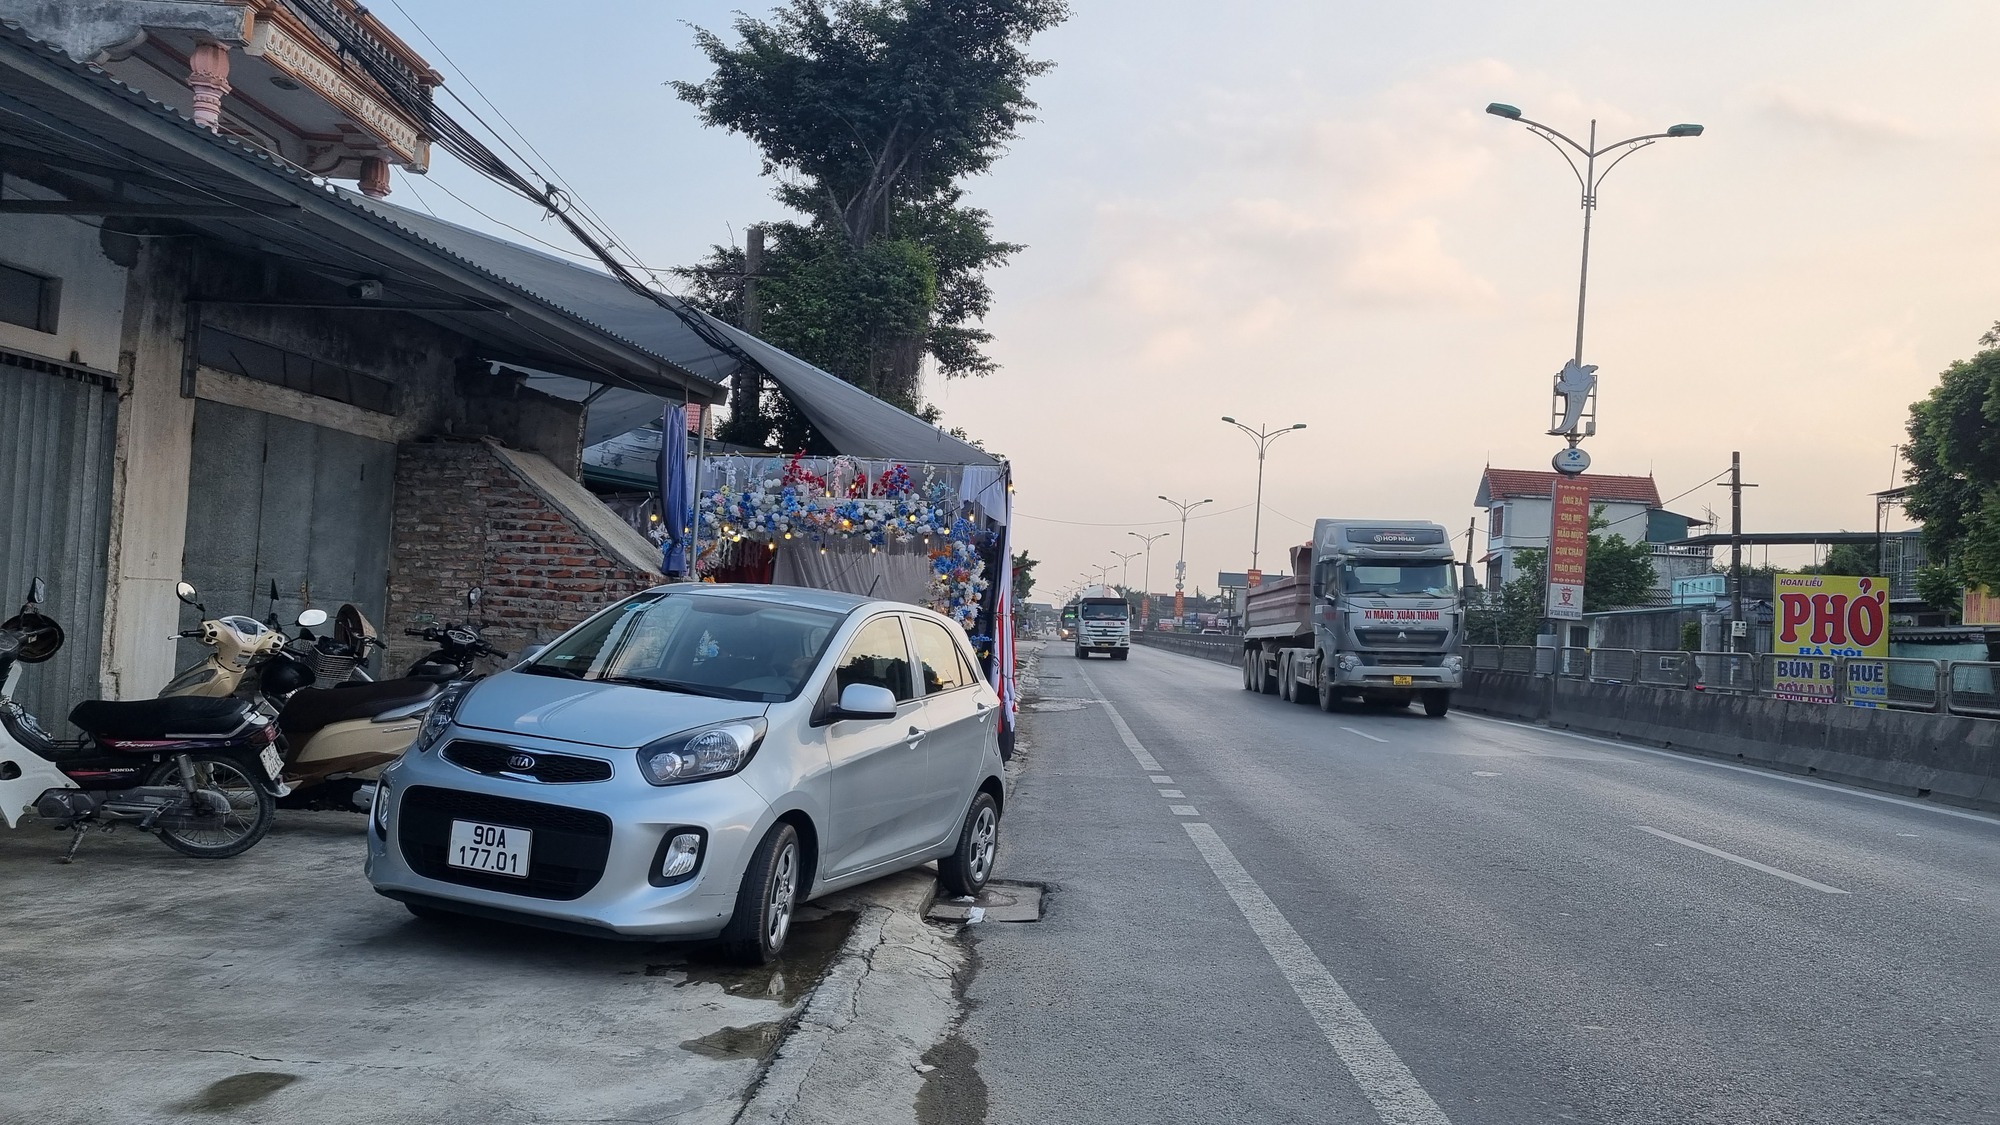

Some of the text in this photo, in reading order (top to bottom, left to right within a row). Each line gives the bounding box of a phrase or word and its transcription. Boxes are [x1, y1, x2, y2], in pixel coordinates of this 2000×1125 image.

[1780, 578, 1804, 586] HOAN
[1364, 610, 1372, 620] XI
[1416, 609, 1439, 621] THÀNH
[1779, 577, 1886, 647] PHỞ
[1799, 646, 1824, 656] HÀ
[1777, 659, 1813, 679] BÚN
[510, 756, 529, 767] KIA
[473, 825, 507, 849] 90A
[459, 845, 518, 873] 177.01
